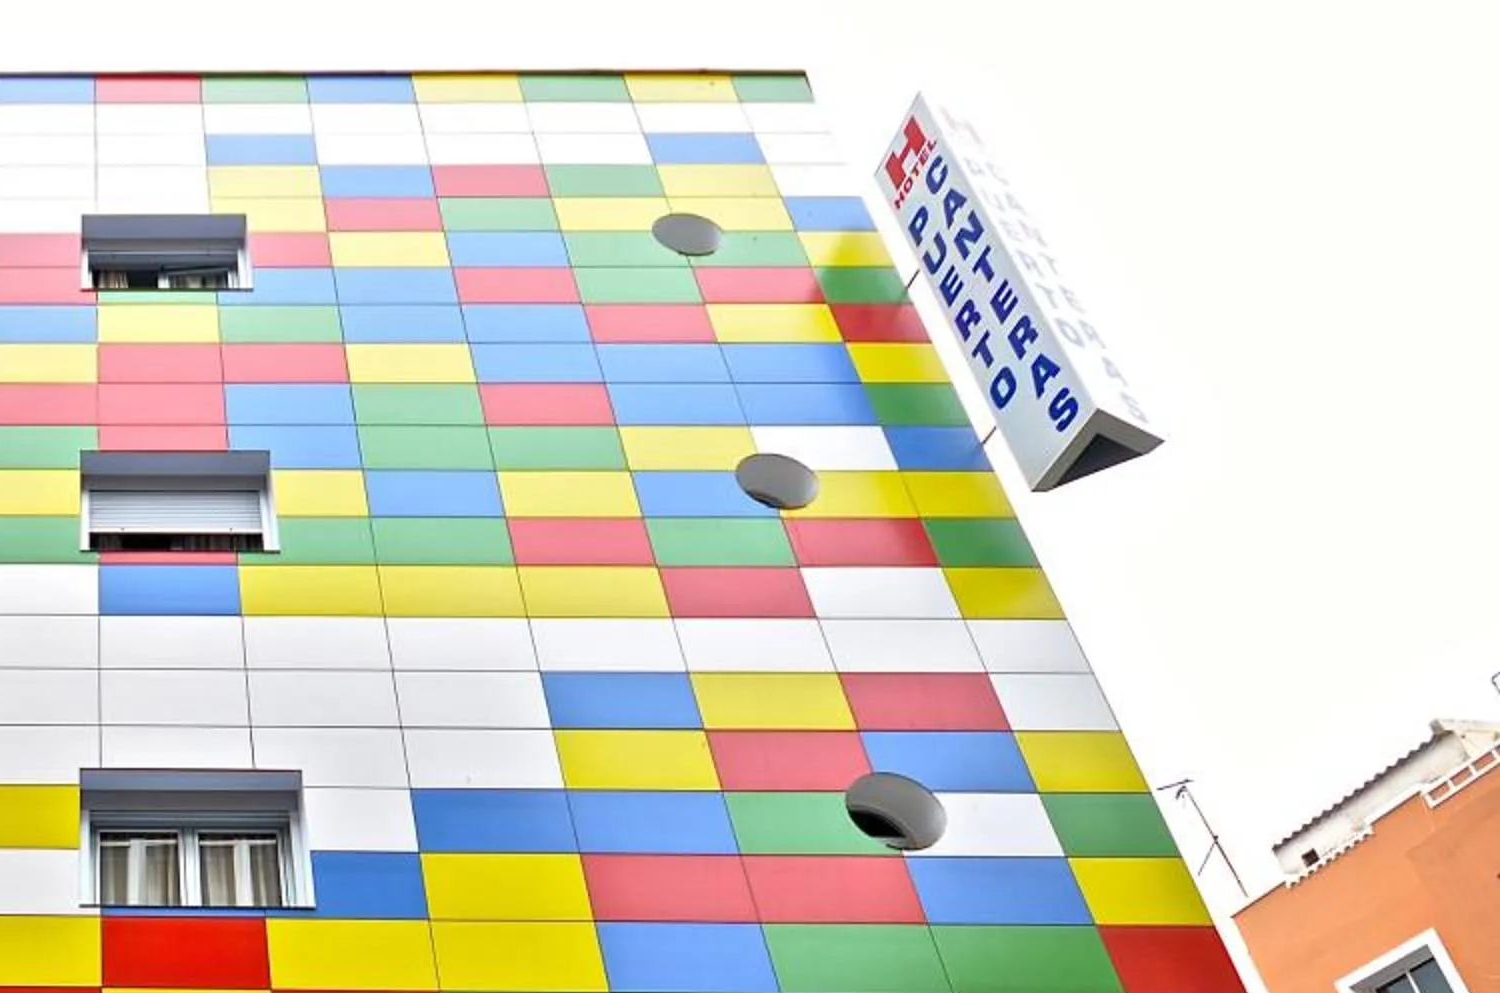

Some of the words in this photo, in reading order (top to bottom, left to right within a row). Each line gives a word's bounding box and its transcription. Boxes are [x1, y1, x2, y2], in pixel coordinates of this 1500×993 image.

[886, 115, 927, 191] H
[894, 140, 938, 210] HOTEL
[908, 205, 1018, 410] PUERTO
[925, 154, 1079, 433] CANTERAS
